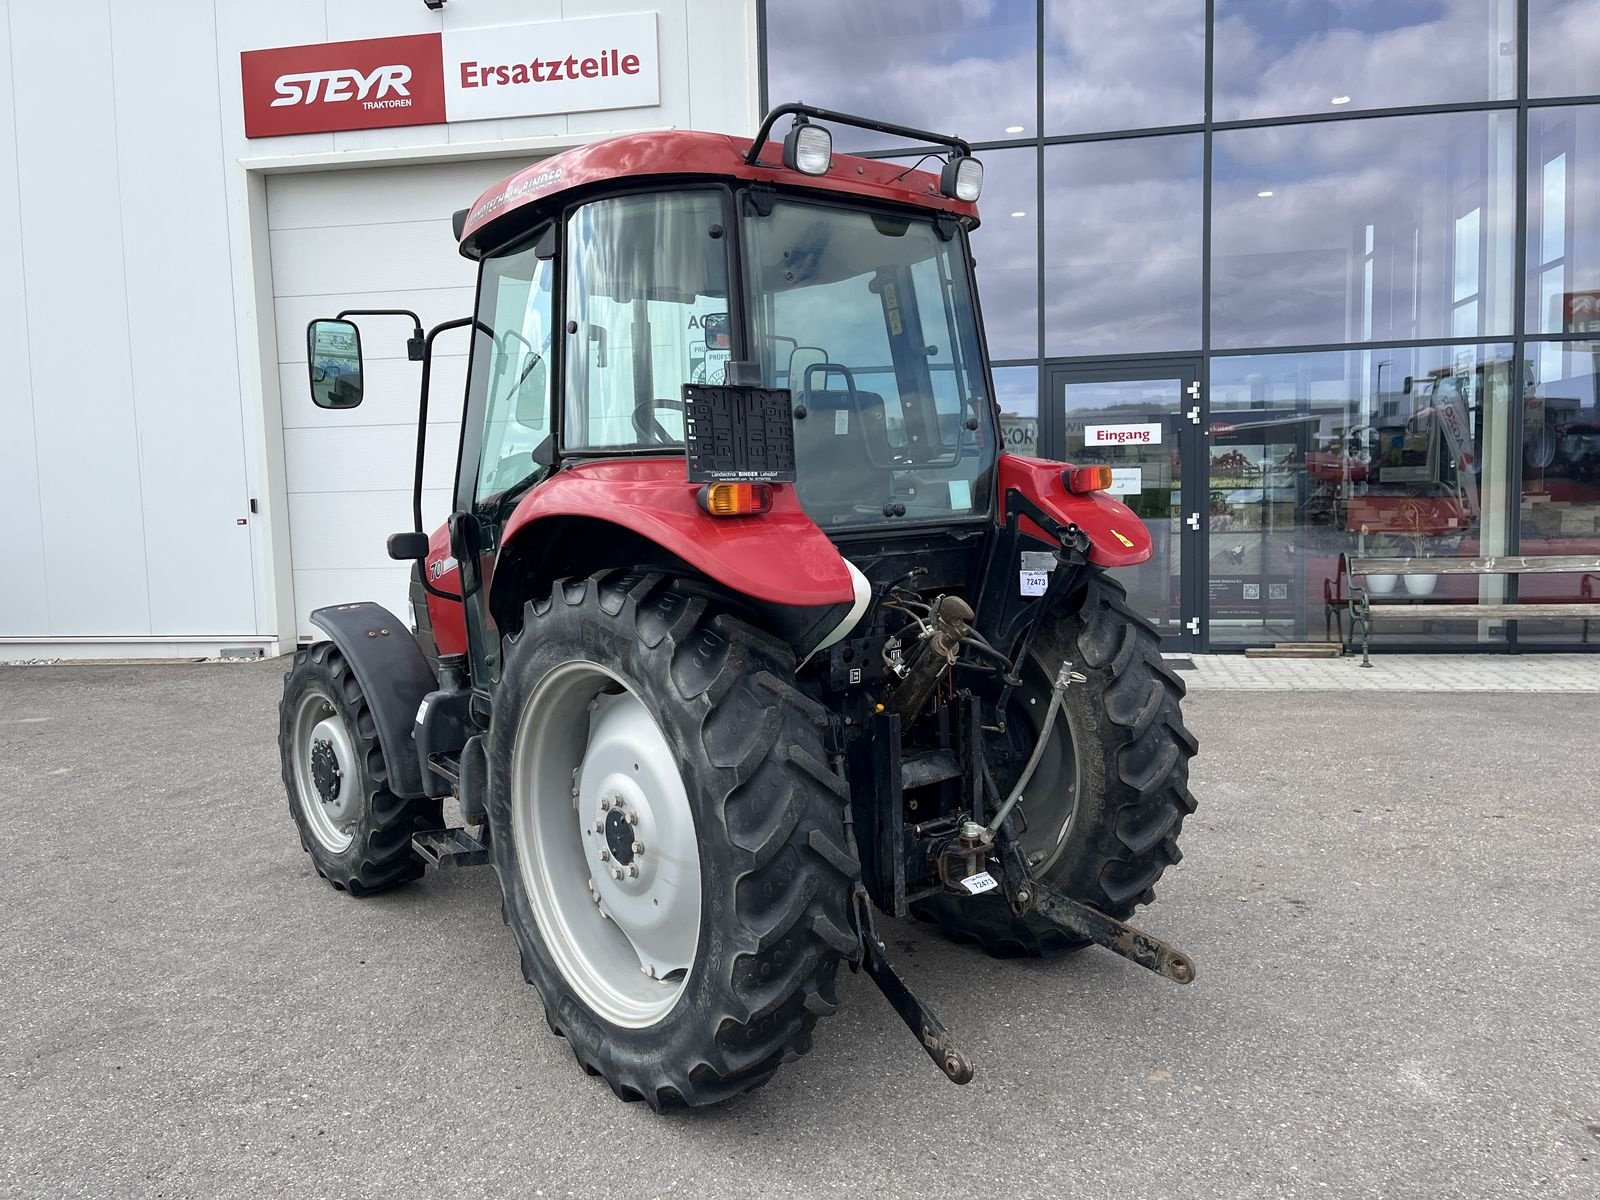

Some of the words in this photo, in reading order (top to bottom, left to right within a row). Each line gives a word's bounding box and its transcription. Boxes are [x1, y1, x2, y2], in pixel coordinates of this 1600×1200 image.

[460, 49, 640, 89] Ersatzteile
[270, 64, 412, 107] STEYR
[362, 99, 412, 110] TRAKTOREN
[1096, 430, 1150, 443] Eingang
[429, 559, 443, 582] 70
[1026, 578, 1046, 586] 72473
[972, 878, 994, 889] 72473
